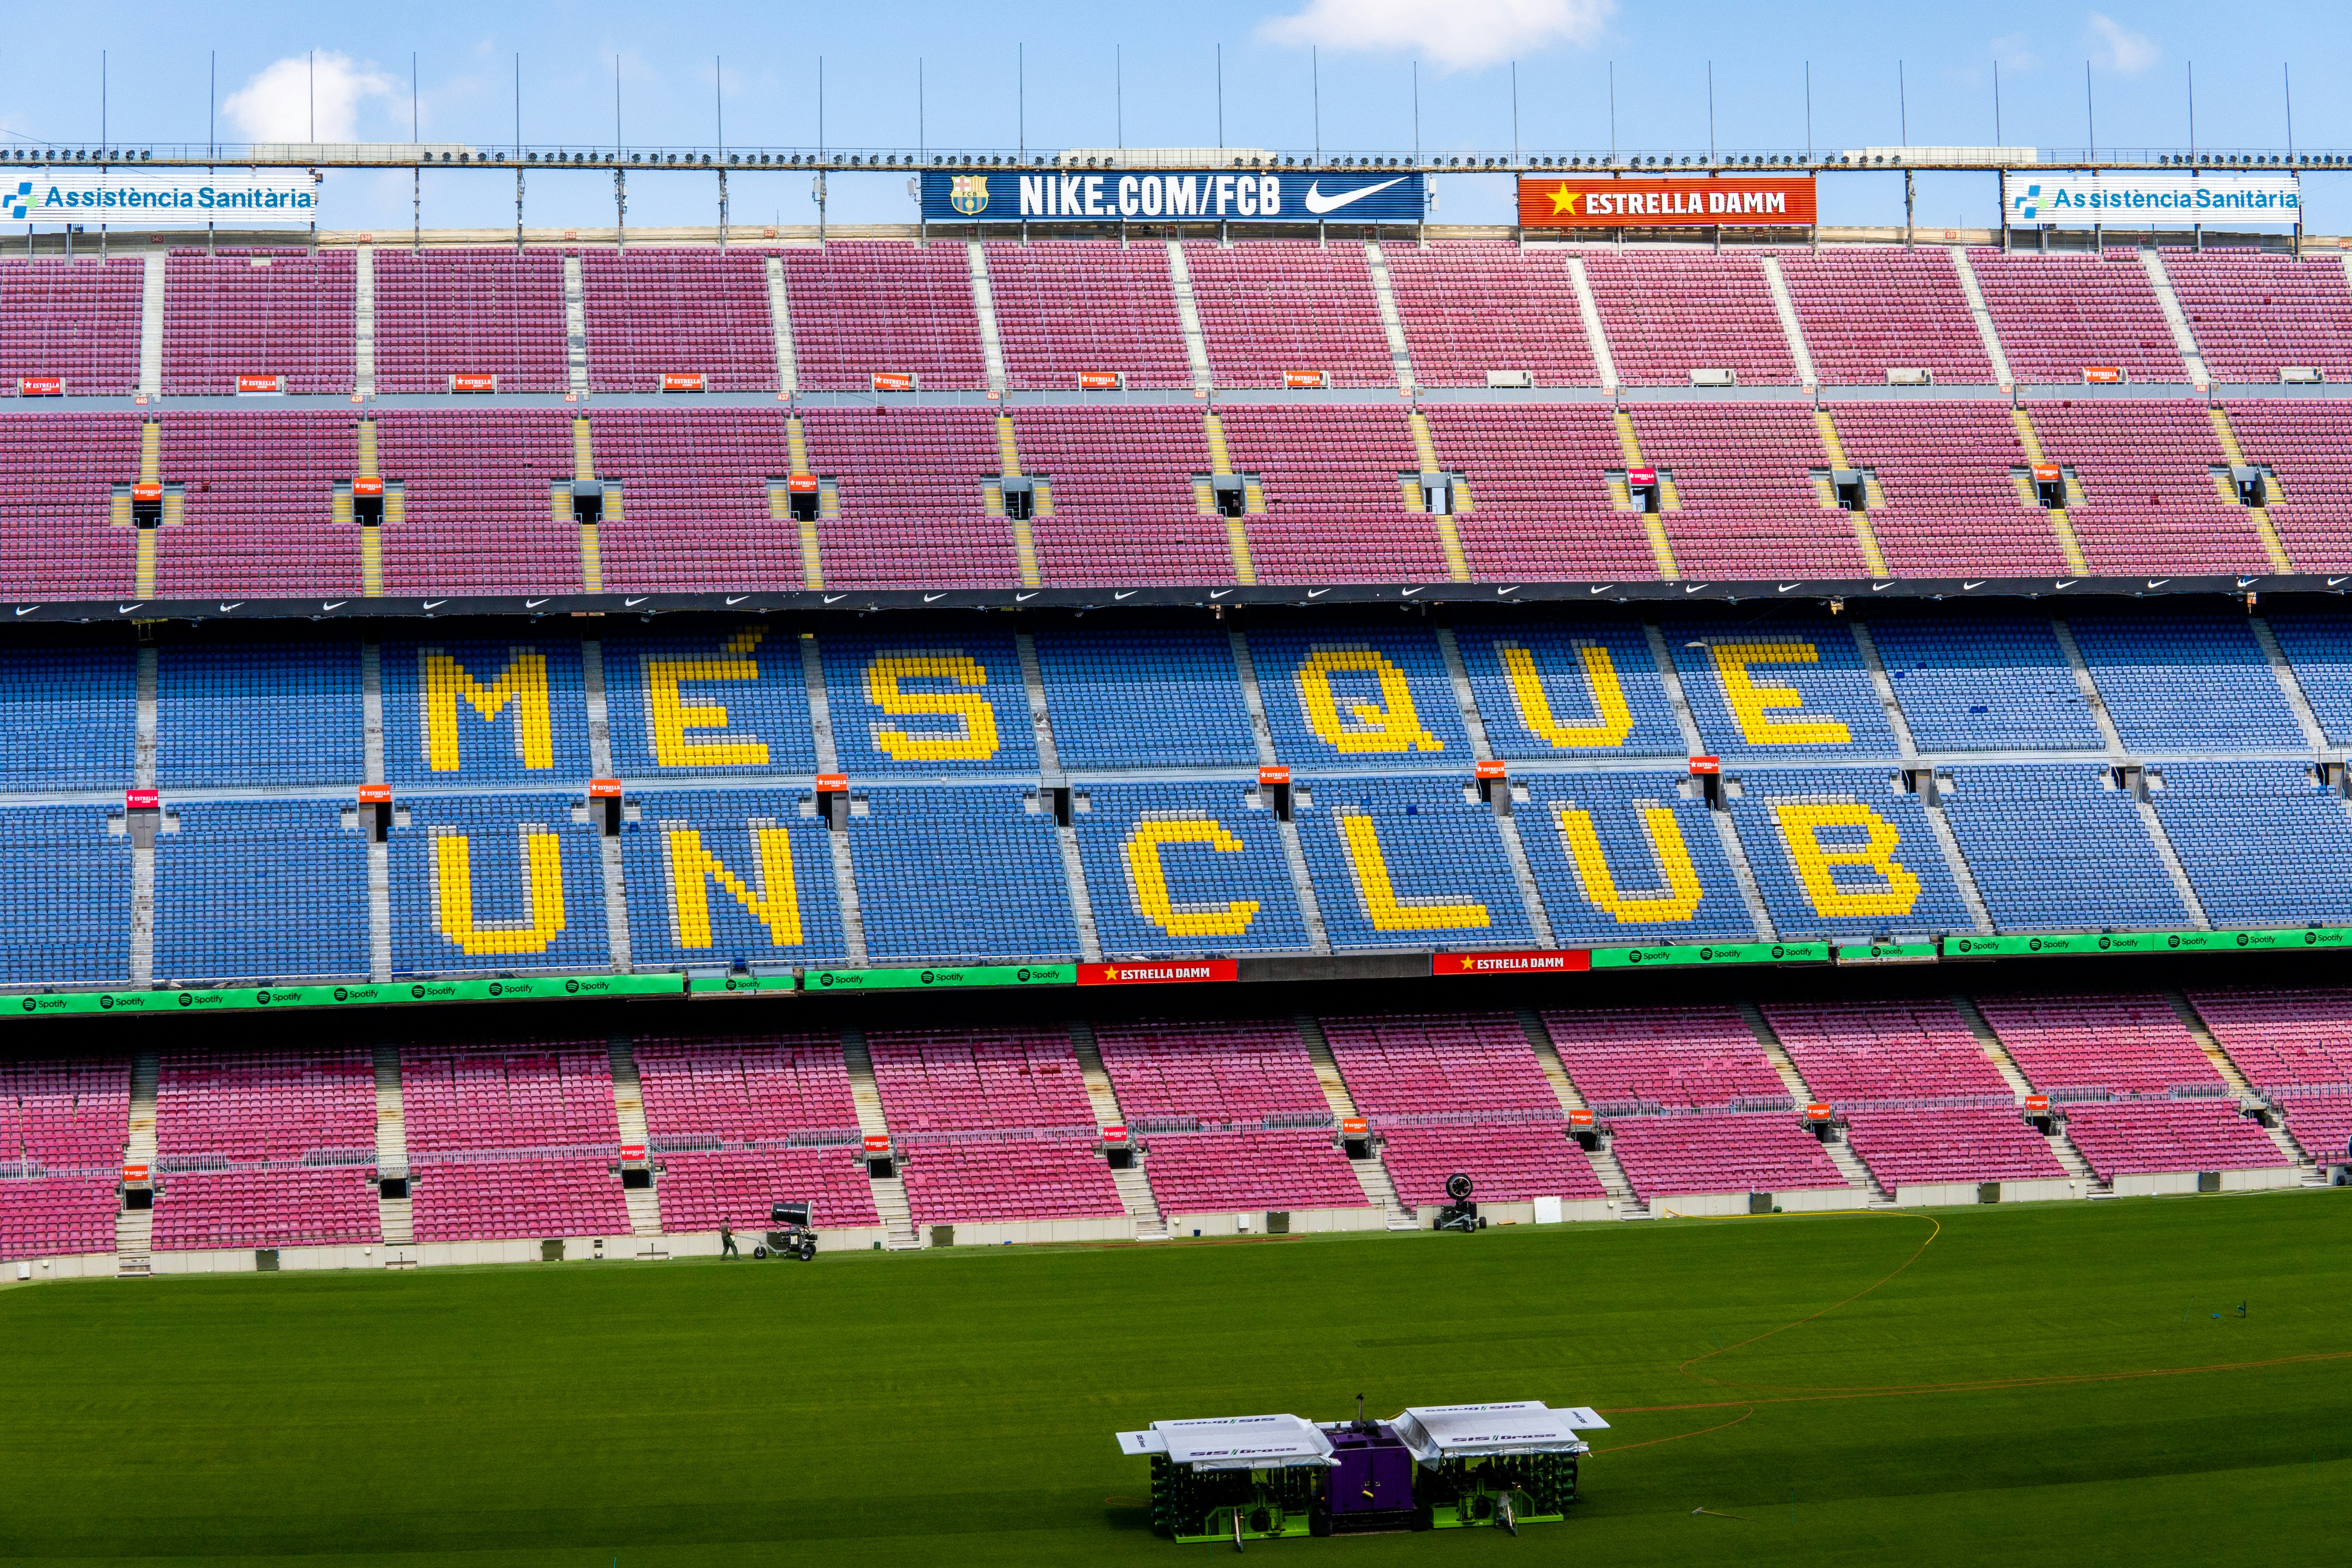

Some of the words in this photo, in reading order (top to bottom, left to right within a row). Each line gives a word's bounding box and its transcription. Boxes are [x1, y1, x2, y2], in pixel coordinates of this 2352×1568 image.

[45, 186, 193, 207] Assistència
[198, 187, 311, 207] Sanitària
[1020, 176, 1280, 216] NIKE.COM/FCB
[2054, 189, 2191, 208] Assistència
[2196, 189, 2298, 208] Sanitària
[1586, 193, 1704, 214] ESTRELLA
[1708, 192, 1786, 213] DAMM
[424, 624, 1000, 771] MÉS
[1297, 643, 1853, 753] QUE
[436, 828, 803, 955] UN
[1127, 803, 1922, 937] CLUB
[2181, 937, 2207, 946] Spotify
[2250, 935, 2275, 944] Spotify
[2318, 933, 2343, 942] Spotify
[1973, 942, 1999, 950] Spotify
[2043, 940, 2069, 948] Spotify
[2112, 938, 2138, 947] Spotify
[1644, 951, 1670, 960] Spotify
[1714, 950, 1740, 958] Spotify
[1786, 948, 1812, 956] Spotify
[1882, 947, 1903, 955] Spotify
[1477, 959, 1528, 969] ESTRELLA
[1530, 958, 1564, 968] DAMM
[936, 973, 964, 982] Spotify
[1032, 971, 1060, 979] Spotify
[1121, 969, 1174, 980] ESTRELLA
[1175, 967, 1210, 978] DAMM
[835, 975, 863, 984] Spotify
[505, 985, 533, 994] Spotify
[581, 981, 609, 990] Spotify
[350, 990, 378, 998] Spotify
[427, 987, 456, 996] Spotify
[194, 996, 223, 1004] Spotify
[272, 993, 301, 1002] Spotify
[38, 1000, 67, 1009] Spotify
[116, 998, 145, 1007] Spotify
